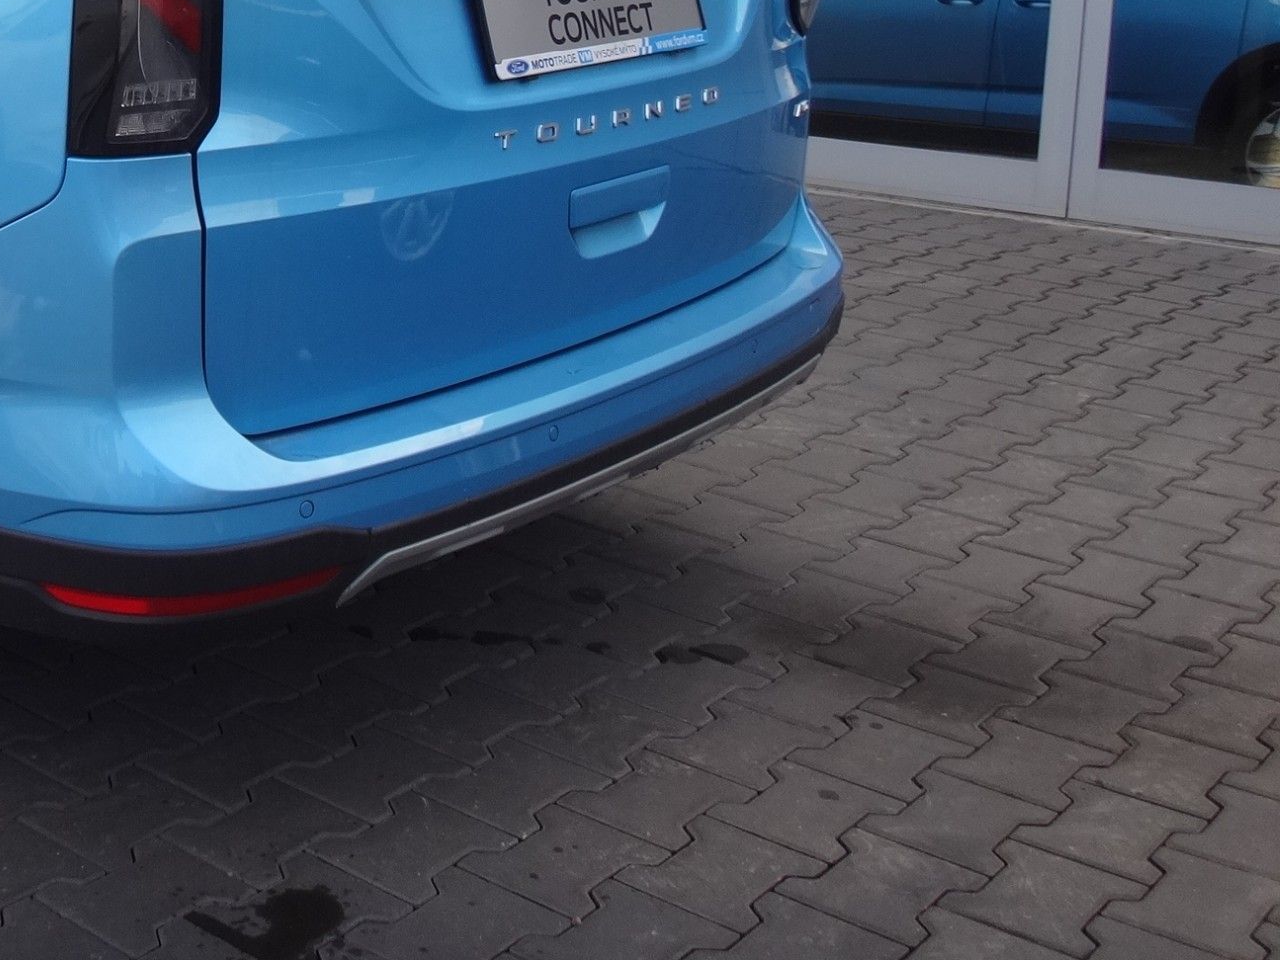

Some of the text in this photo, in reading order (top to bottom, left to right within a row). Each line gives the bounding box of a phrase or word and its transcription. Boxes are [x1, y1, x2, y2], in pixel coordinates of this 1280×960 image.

[548, 1, 654, 46] CONNECT
[530, 53, 578, 70] MOTOTRADE
[493, 85, 722, 151] TOURNEO
